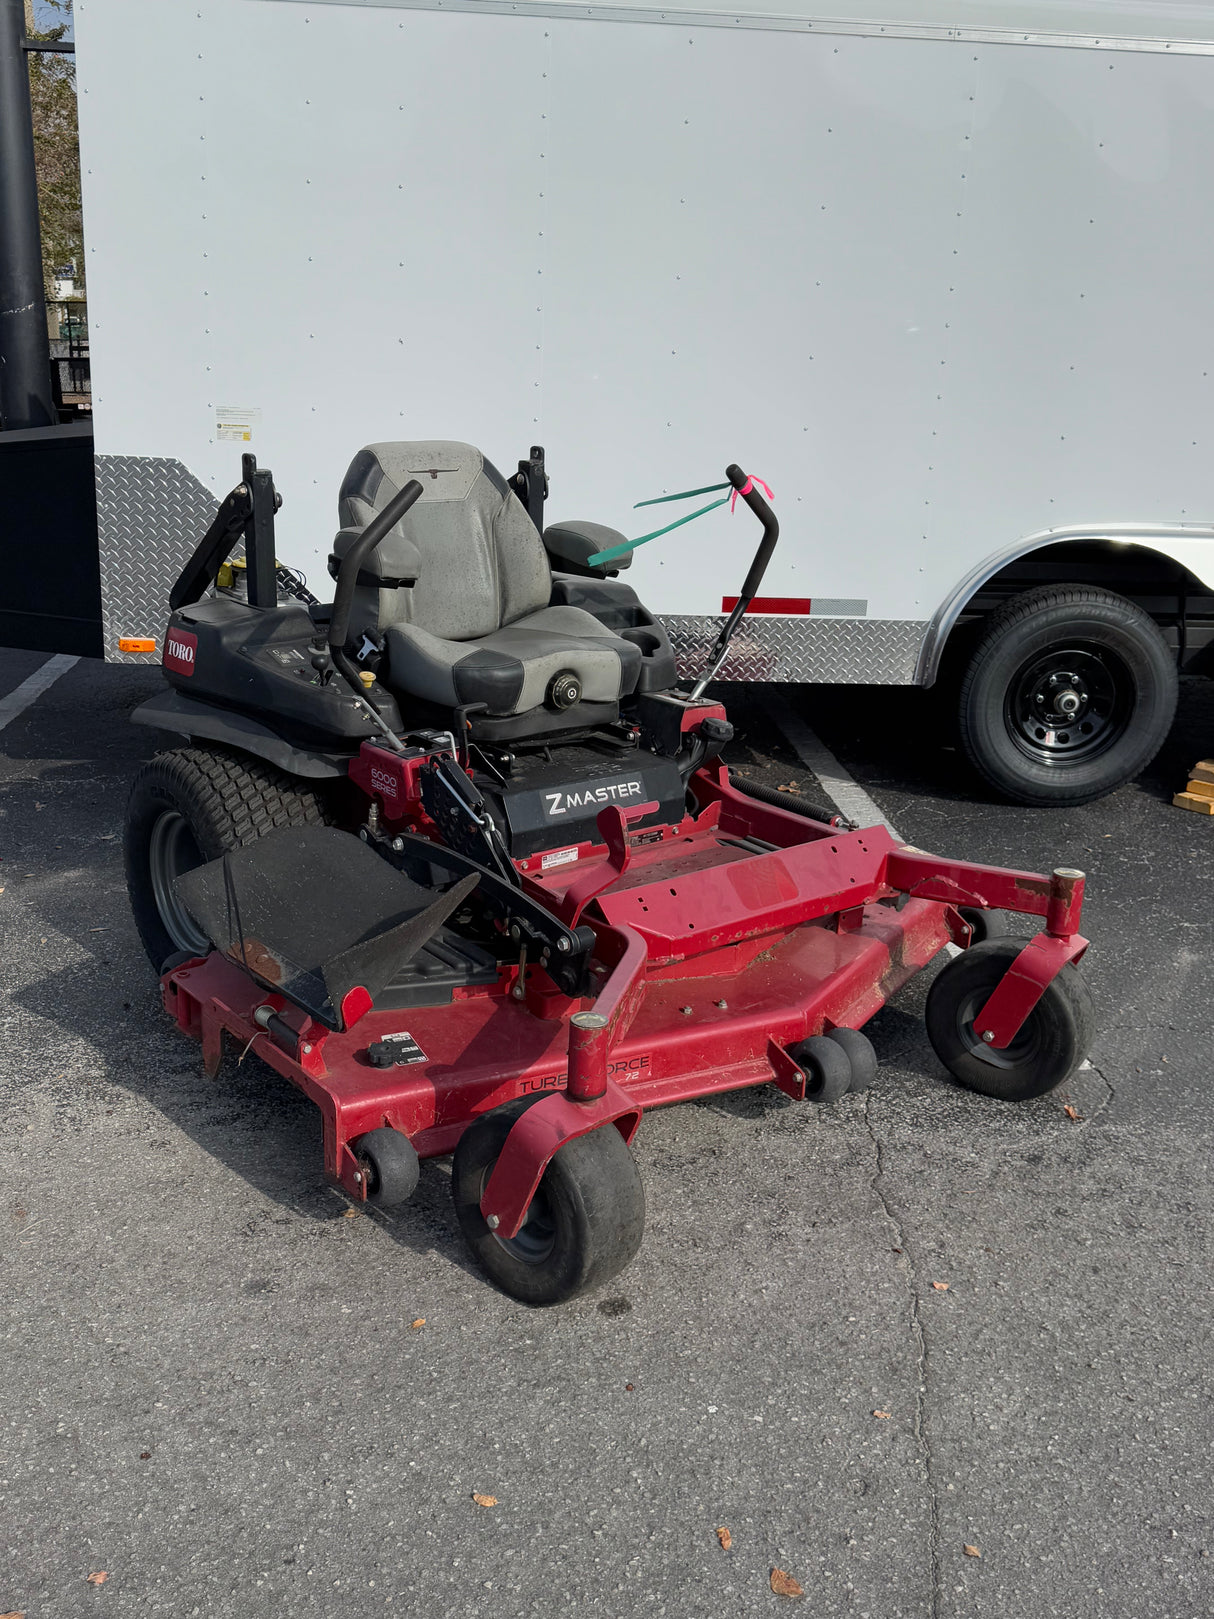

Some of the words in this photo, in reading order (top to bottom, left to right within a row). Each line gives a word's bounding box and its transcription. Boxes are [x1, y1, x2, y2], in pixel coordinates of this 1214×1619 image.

[168, 639, 193, 663] TORO
[371, 768, 397, 787] 6000
[371, 779, 397, 797] SERIES
[545, 792, 567, 815] Z
[566, 781, 642, 808] MASTER
[520, 1073, 568, 1093] TURB
[625, 1071, 639, 1081] 72
